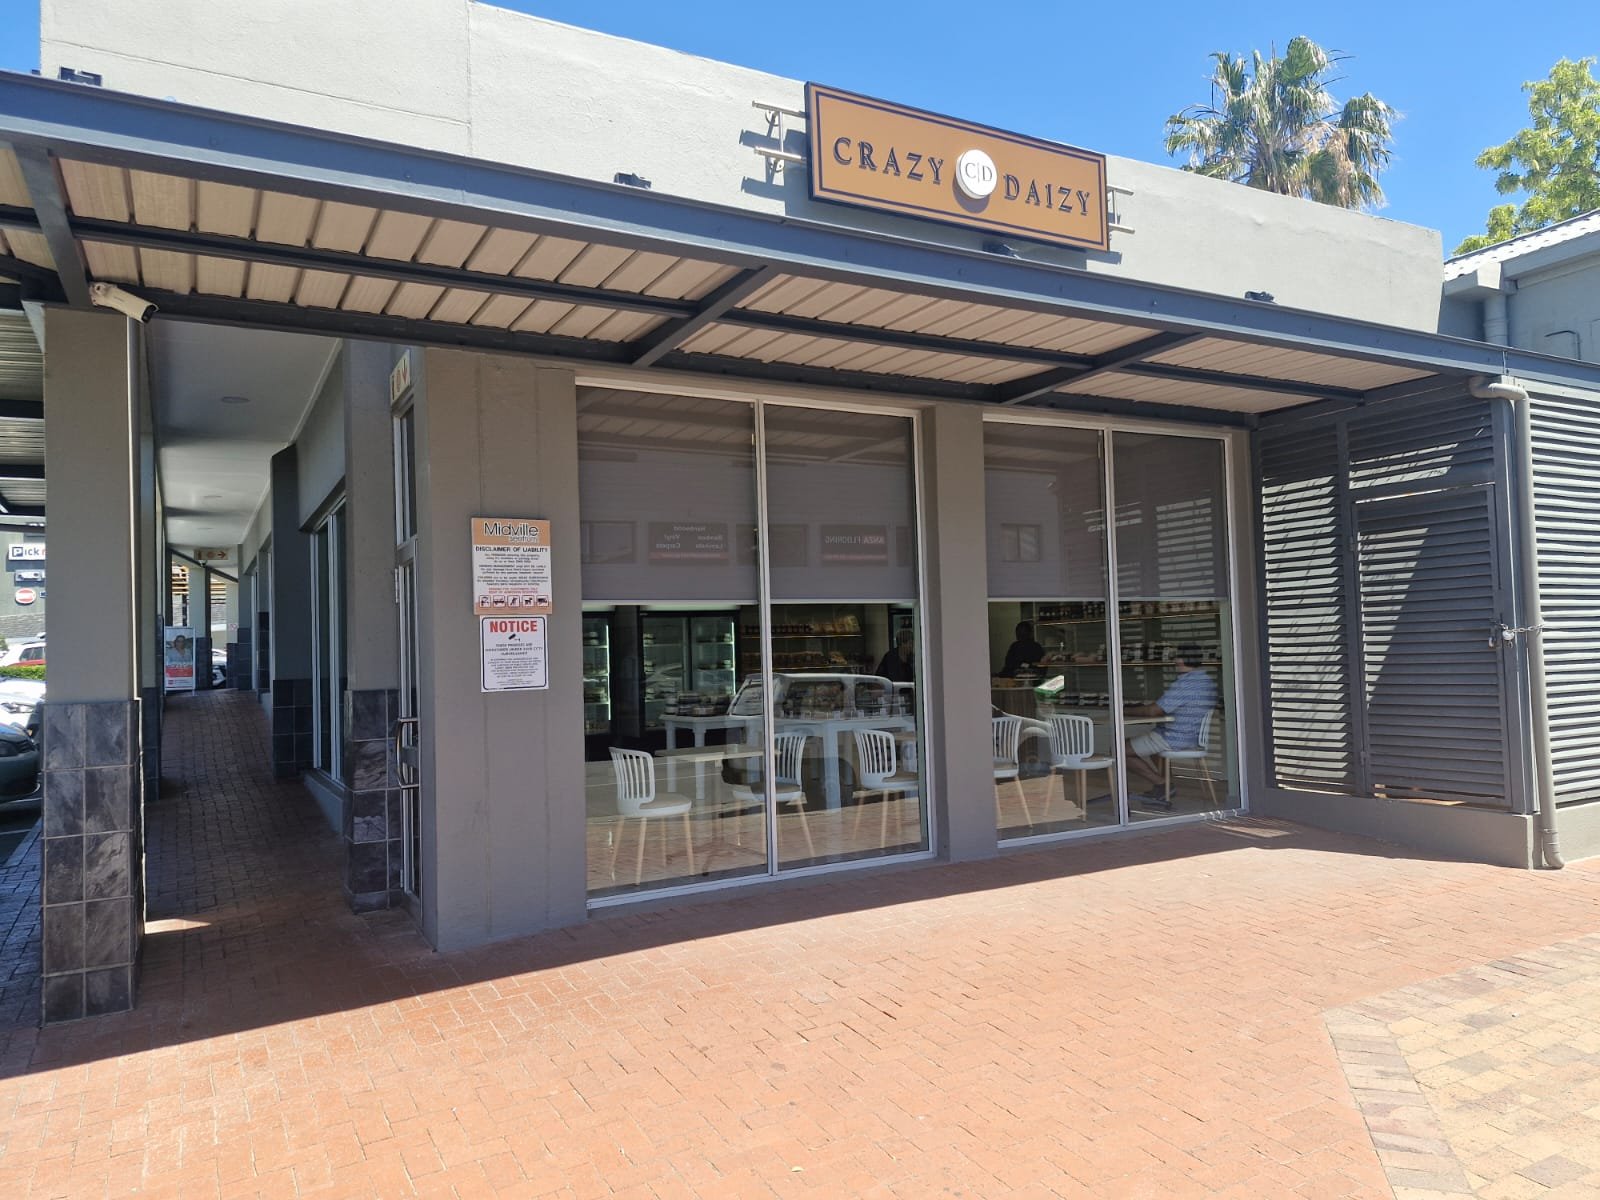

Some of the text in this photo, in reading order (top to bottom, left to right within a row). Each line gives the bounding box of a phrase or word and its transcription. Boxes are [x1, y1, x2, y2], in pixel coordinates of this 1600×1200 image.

[833, 136, 944, 185] CRAZY
[1003, 173, 1090, 216] DAIZY
[484, 522, 539, 536] Midville
[489, 620, 538, 633] NOTICE
